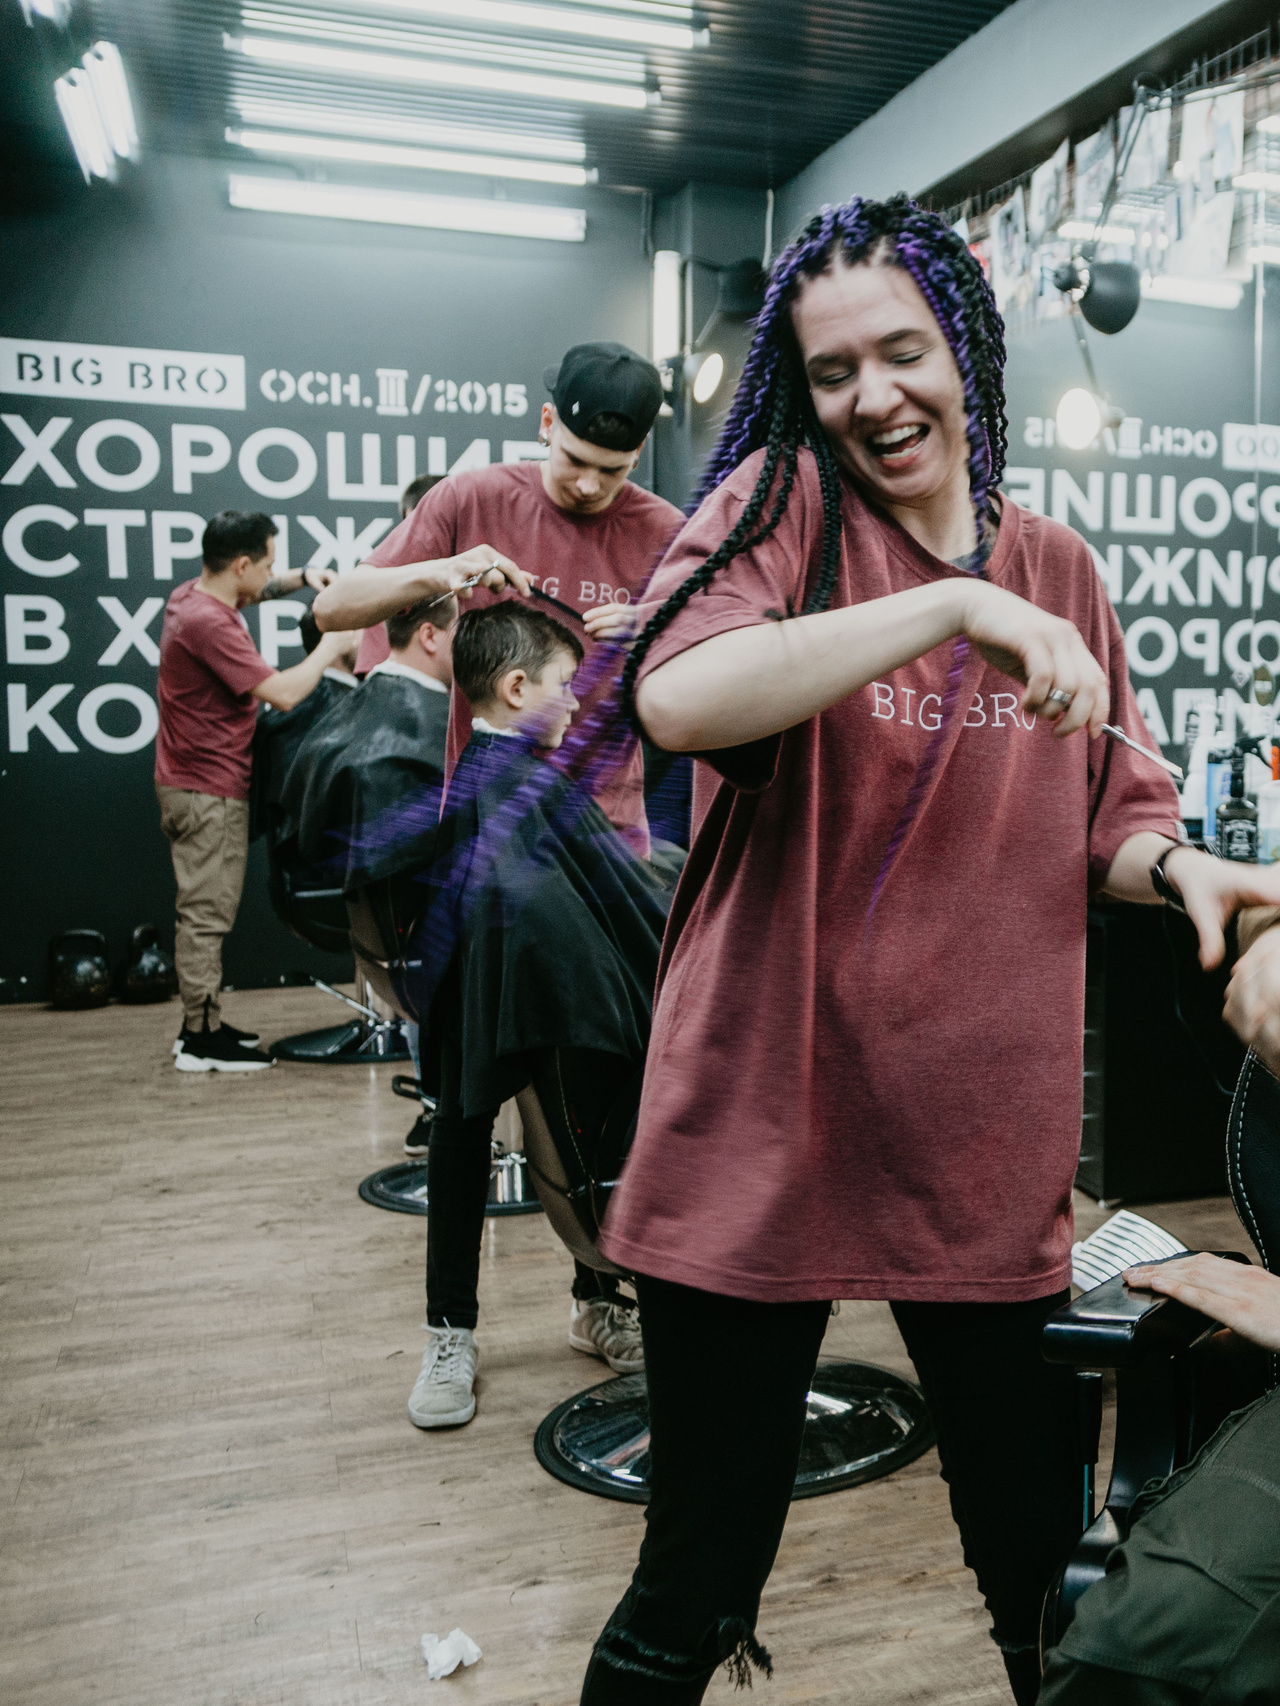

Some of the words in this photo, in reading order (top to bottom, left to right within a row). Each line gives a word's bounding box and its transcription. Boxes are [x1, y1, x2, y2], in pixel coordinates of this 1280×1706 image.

[17, 352, 103, 387] BIG
[128, 361, 228, 394] BRO
[578, 580, 631, 606] BRO
[4, 594, 71, 667] В
[871, 681, 943, 731] BIG
